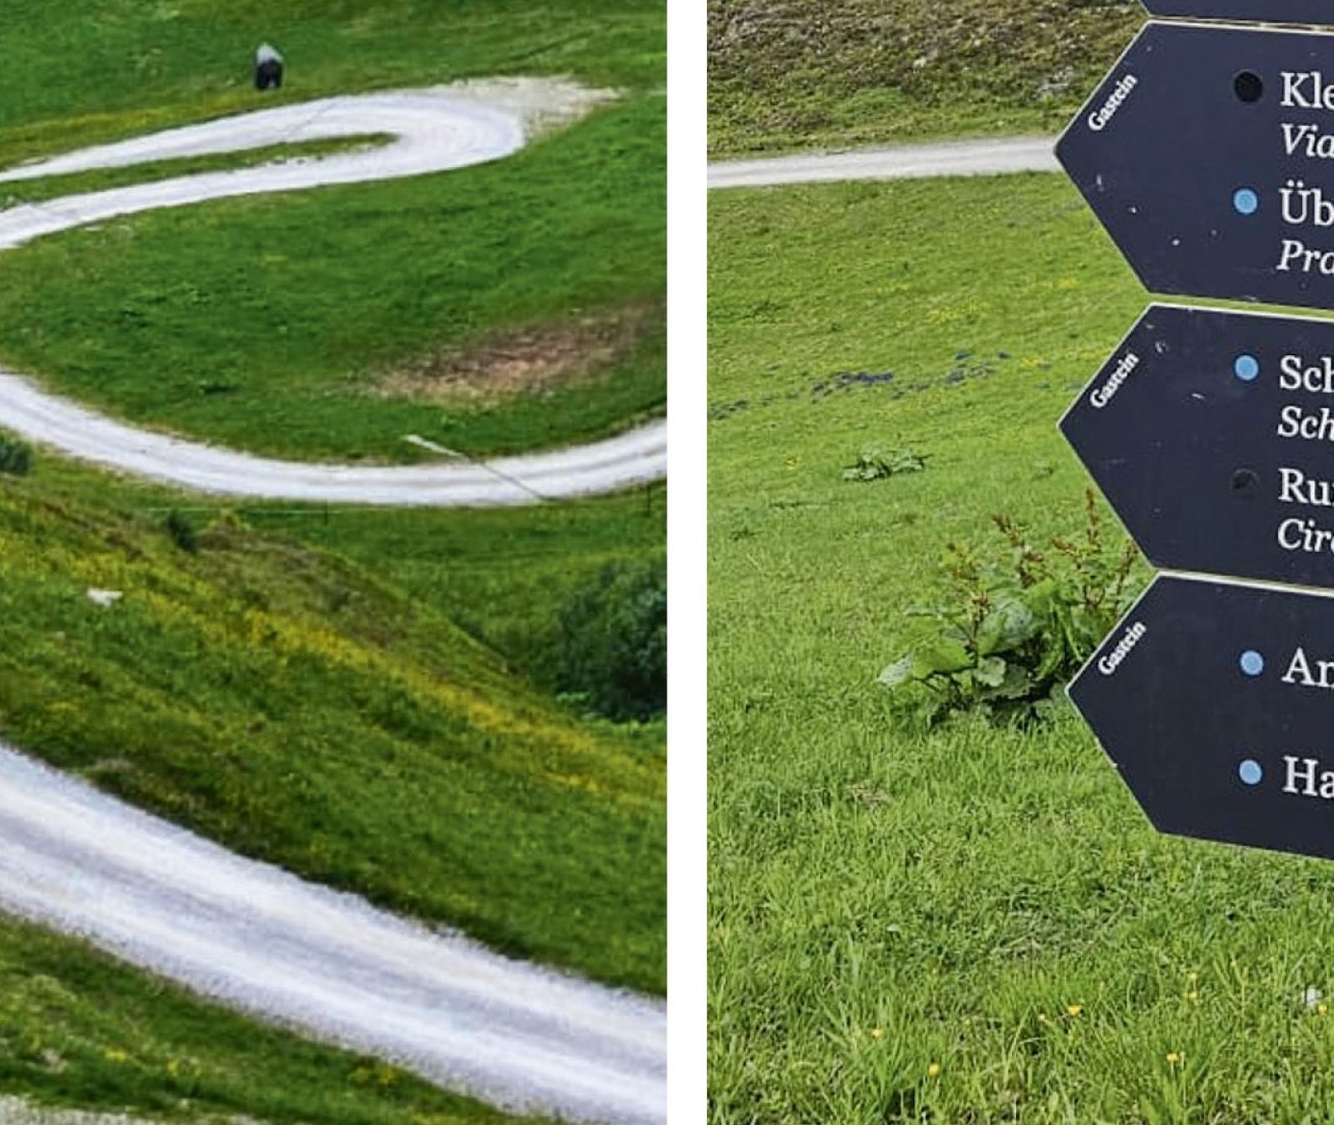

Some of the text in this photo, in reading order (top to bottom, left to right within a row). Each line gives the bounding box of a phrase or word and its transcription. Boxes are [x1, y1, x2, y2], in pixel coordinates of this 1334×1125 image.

[1087, 72, 1139, 133] Gastein
[1088, 350, 1140, 410] Gastein
[1097, 619, 1147, 676] Gastein
